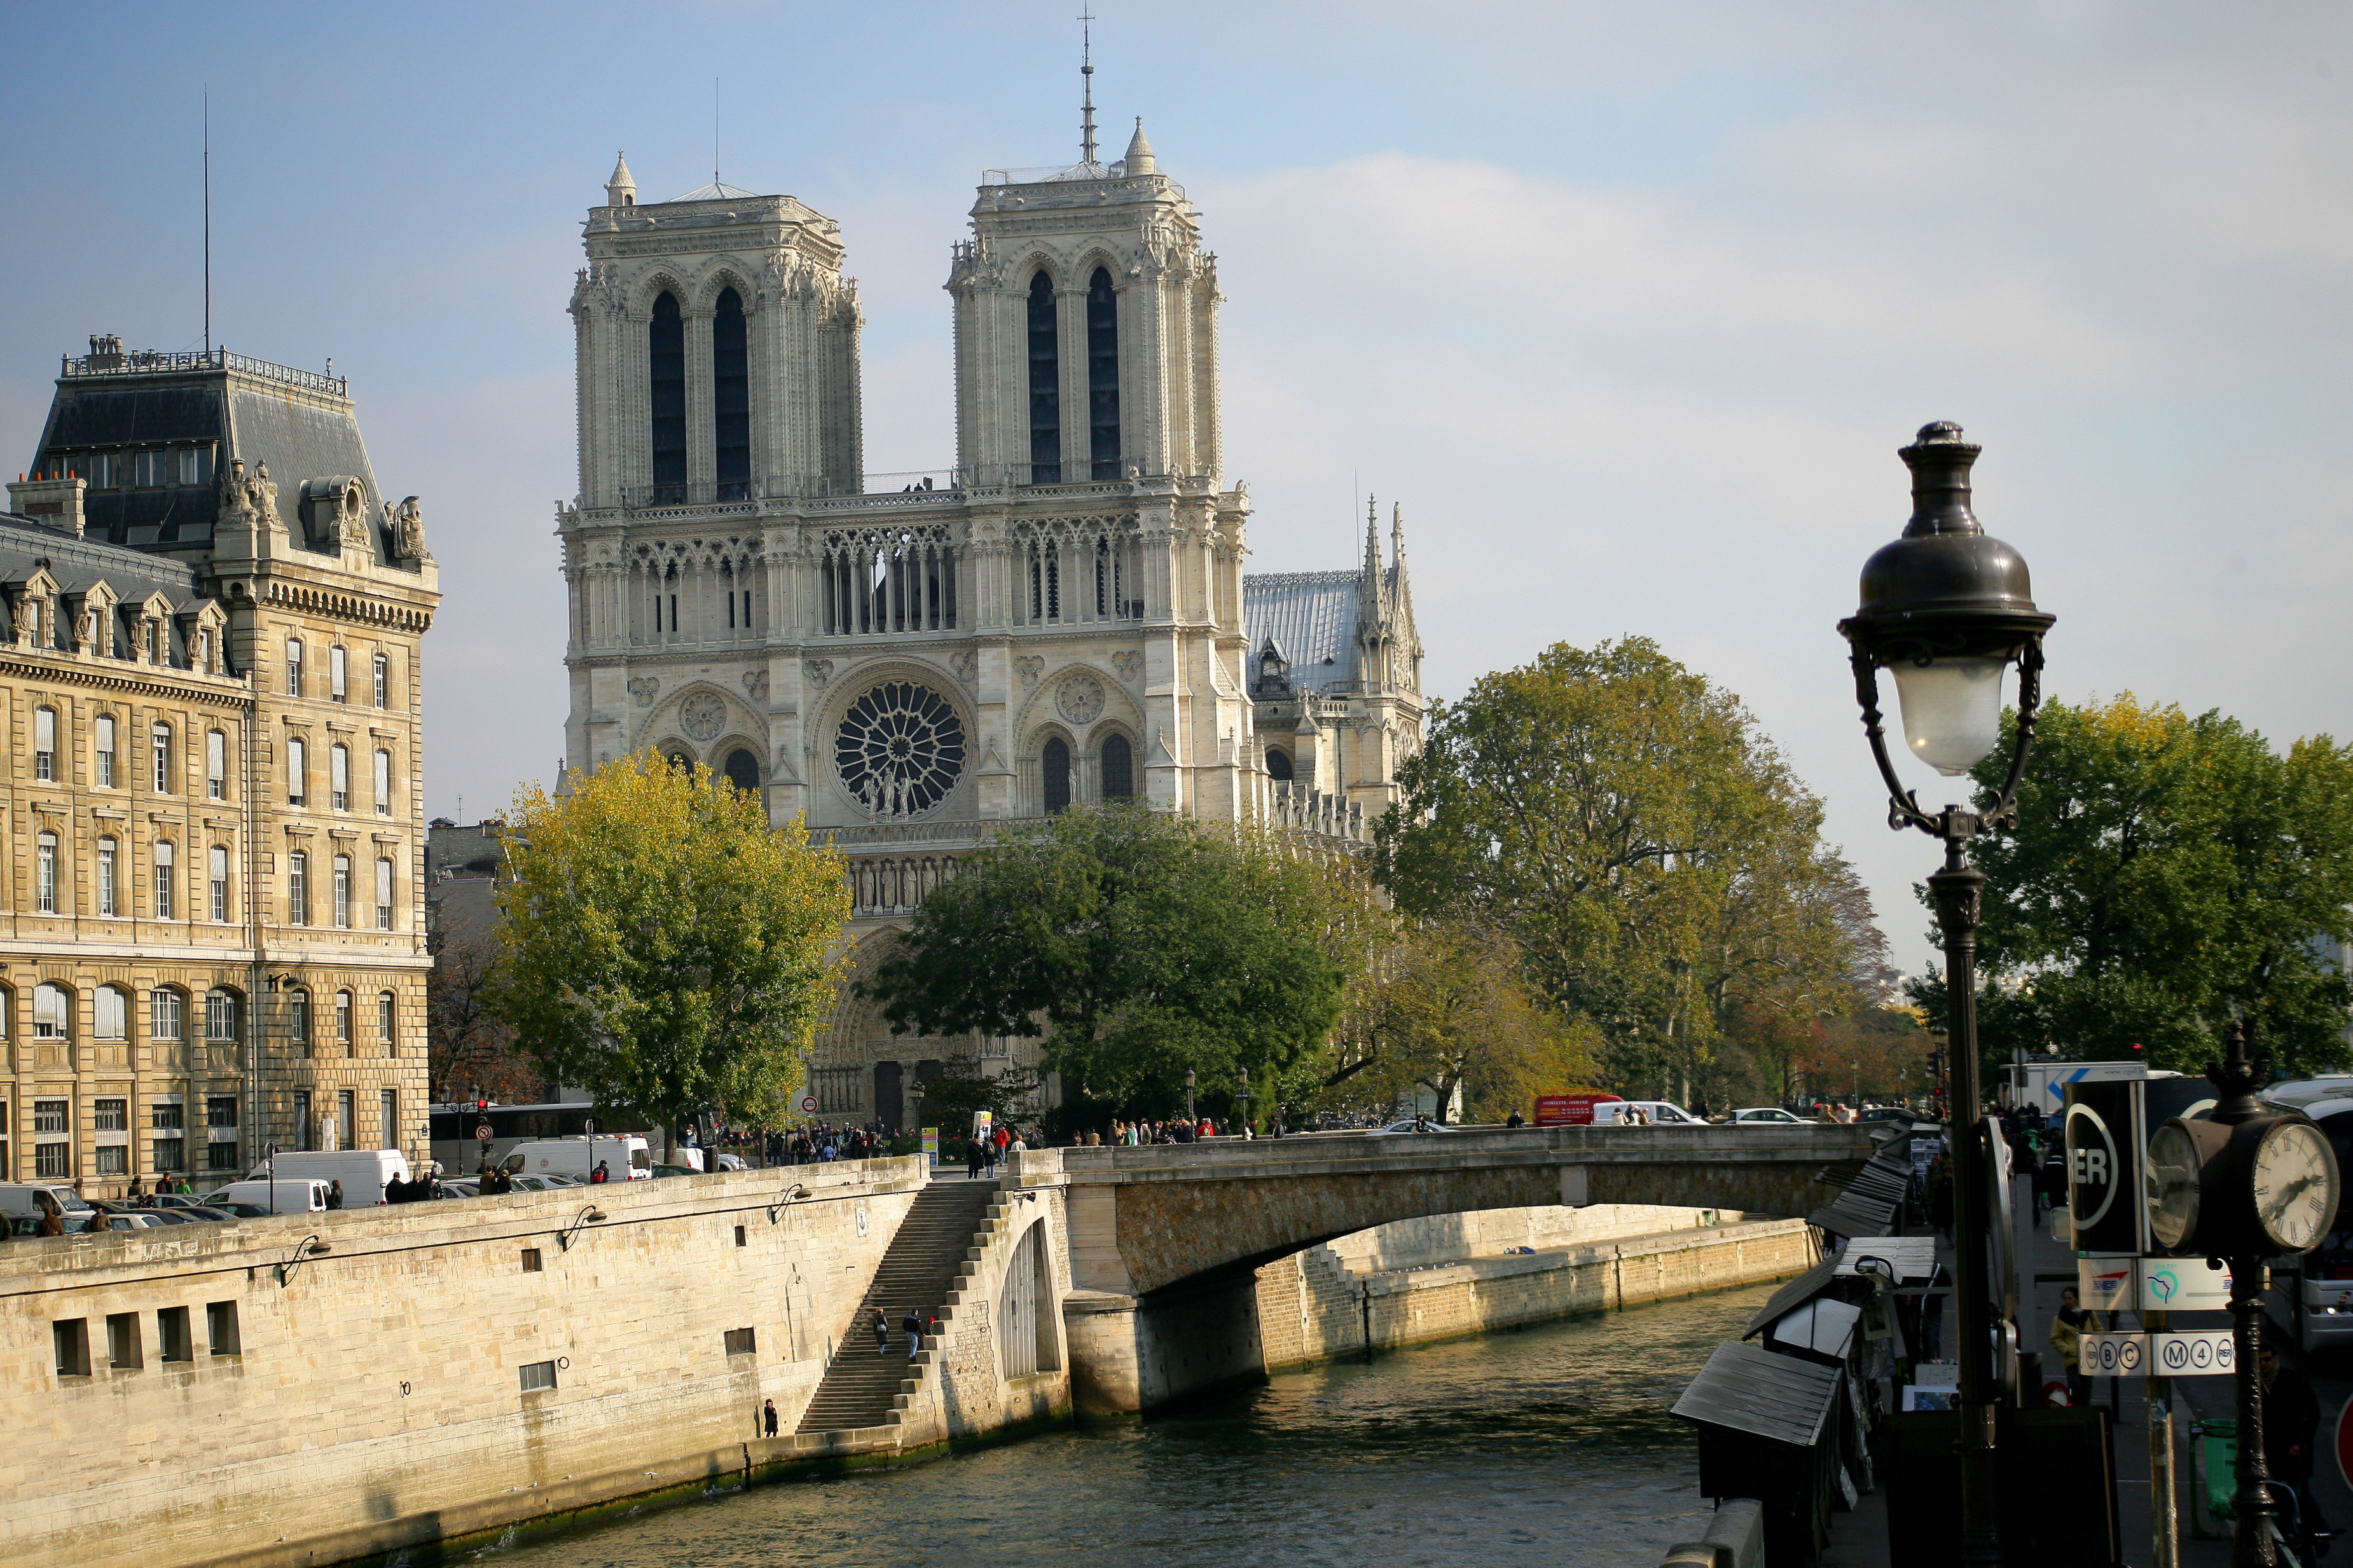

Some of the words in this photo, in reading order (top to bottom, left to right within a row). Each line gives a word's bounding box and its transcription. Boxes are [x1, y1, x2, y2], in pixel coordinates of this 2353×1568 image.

[2104, 1349, 2111, 1361] B
[2125, 1349, 2134, 1362] C
[2169, 1346, 2183, 1363] M
[2197, 1347, 2205, 1360] 4
[2218, 1349, 2231, 1358] RER
